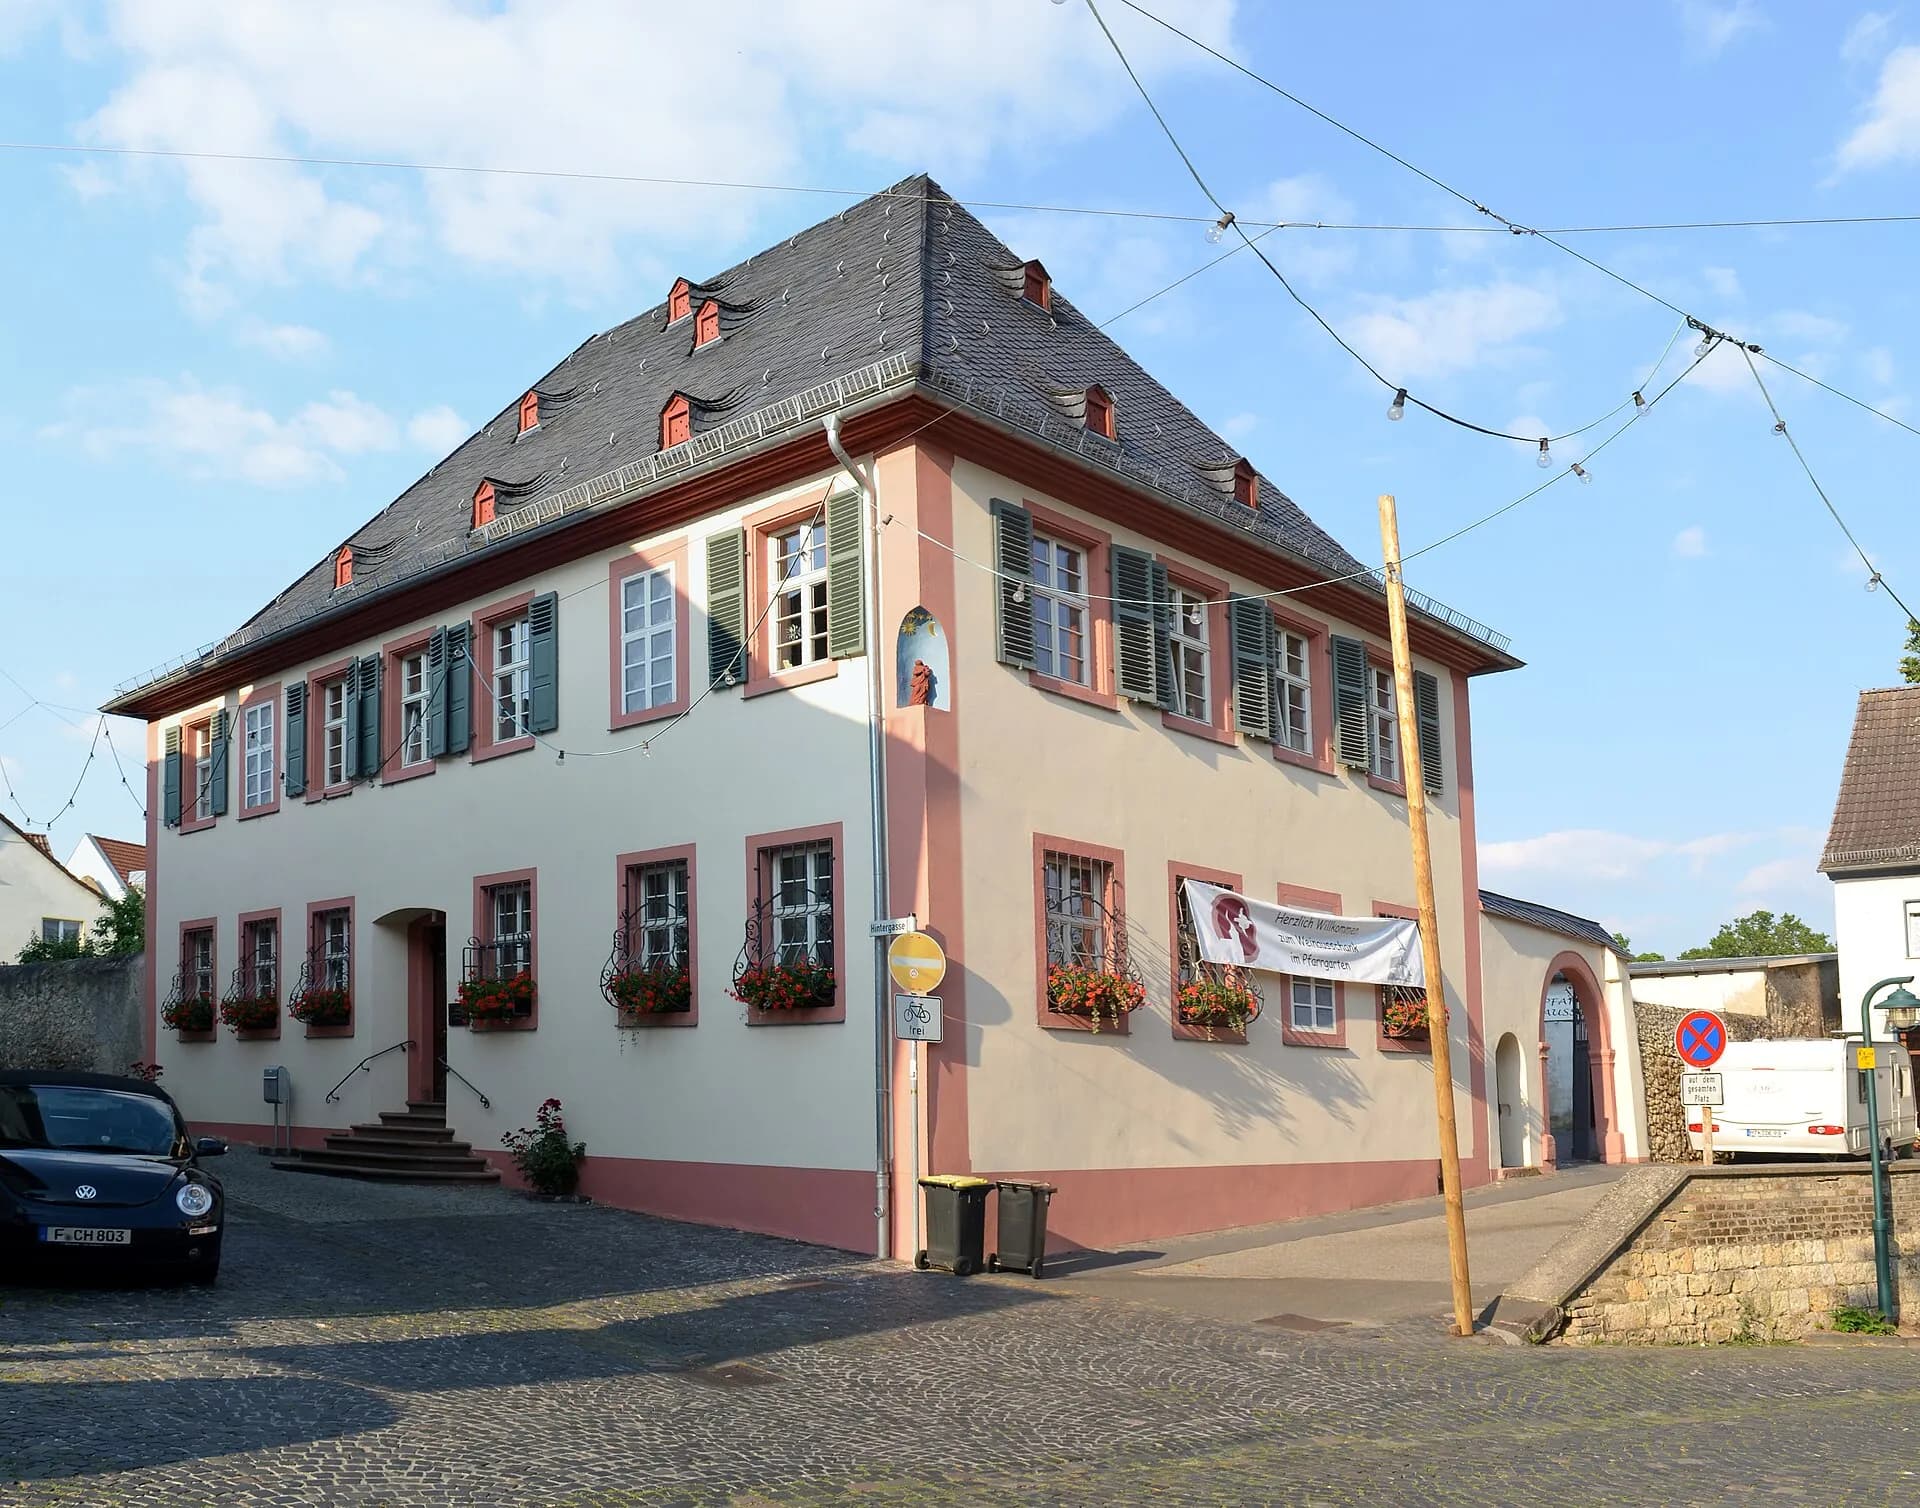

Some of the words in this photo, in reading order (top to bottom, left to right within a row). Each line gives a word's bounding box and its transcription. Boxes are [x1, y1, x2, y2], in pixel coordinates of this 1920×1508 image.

[870, 922, 906, 934] Hintergasse
[1275, 911, 1314, 930] Herzlich
[1315, 919, 1360, 936] Willkommen
[1278, 934, 1296, 946] zum
[1297, 934, 1360, 953] Weinausschank
[1290, 951, 1301, 965] im
[1302, 953, 1352, 972] Pfarrgarten
[909, 1025, 925, 1036] frei
[1688, 1085, 1717, 1094] gesamten
[1694, 1094, 1710, 1102] Platz
